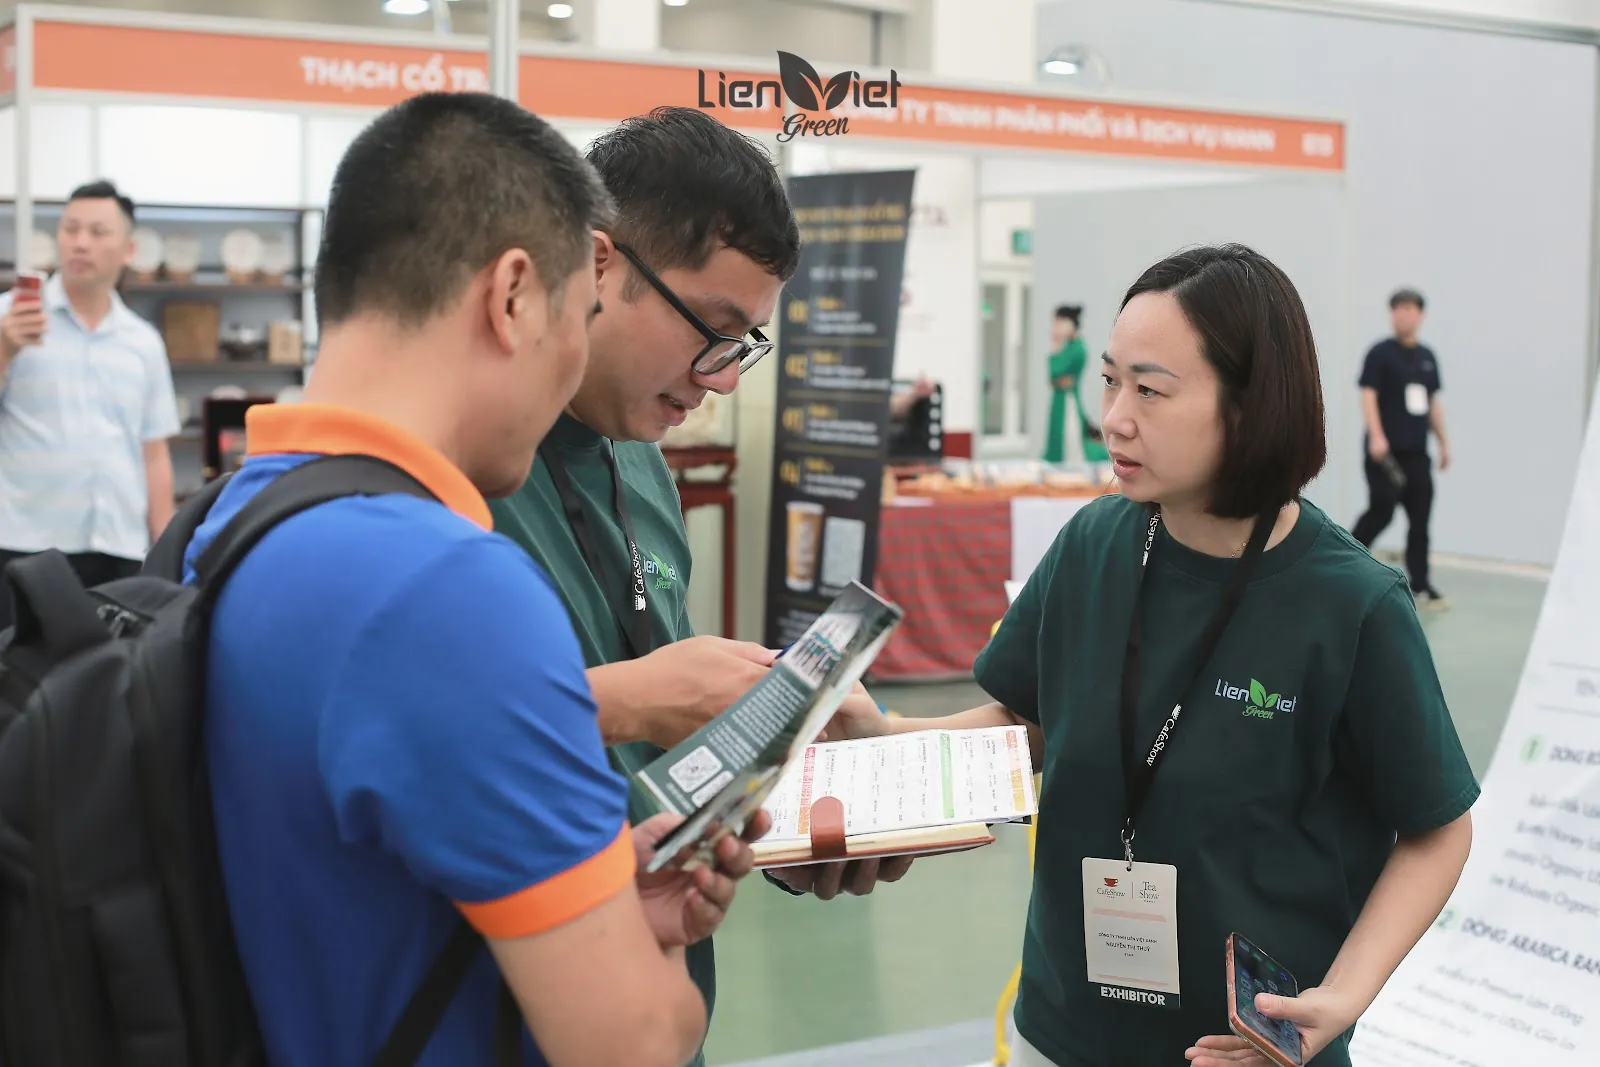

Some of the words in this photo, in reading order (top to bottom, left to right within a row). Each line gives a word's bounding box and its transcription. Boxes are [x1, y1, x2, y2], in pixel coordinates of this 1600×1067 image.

[1242, 704, 1275, 720] Green
[1146, 718, 1175, 767] CafeShow
[1100, 985, 1166, 1006] EXHIBITOR
